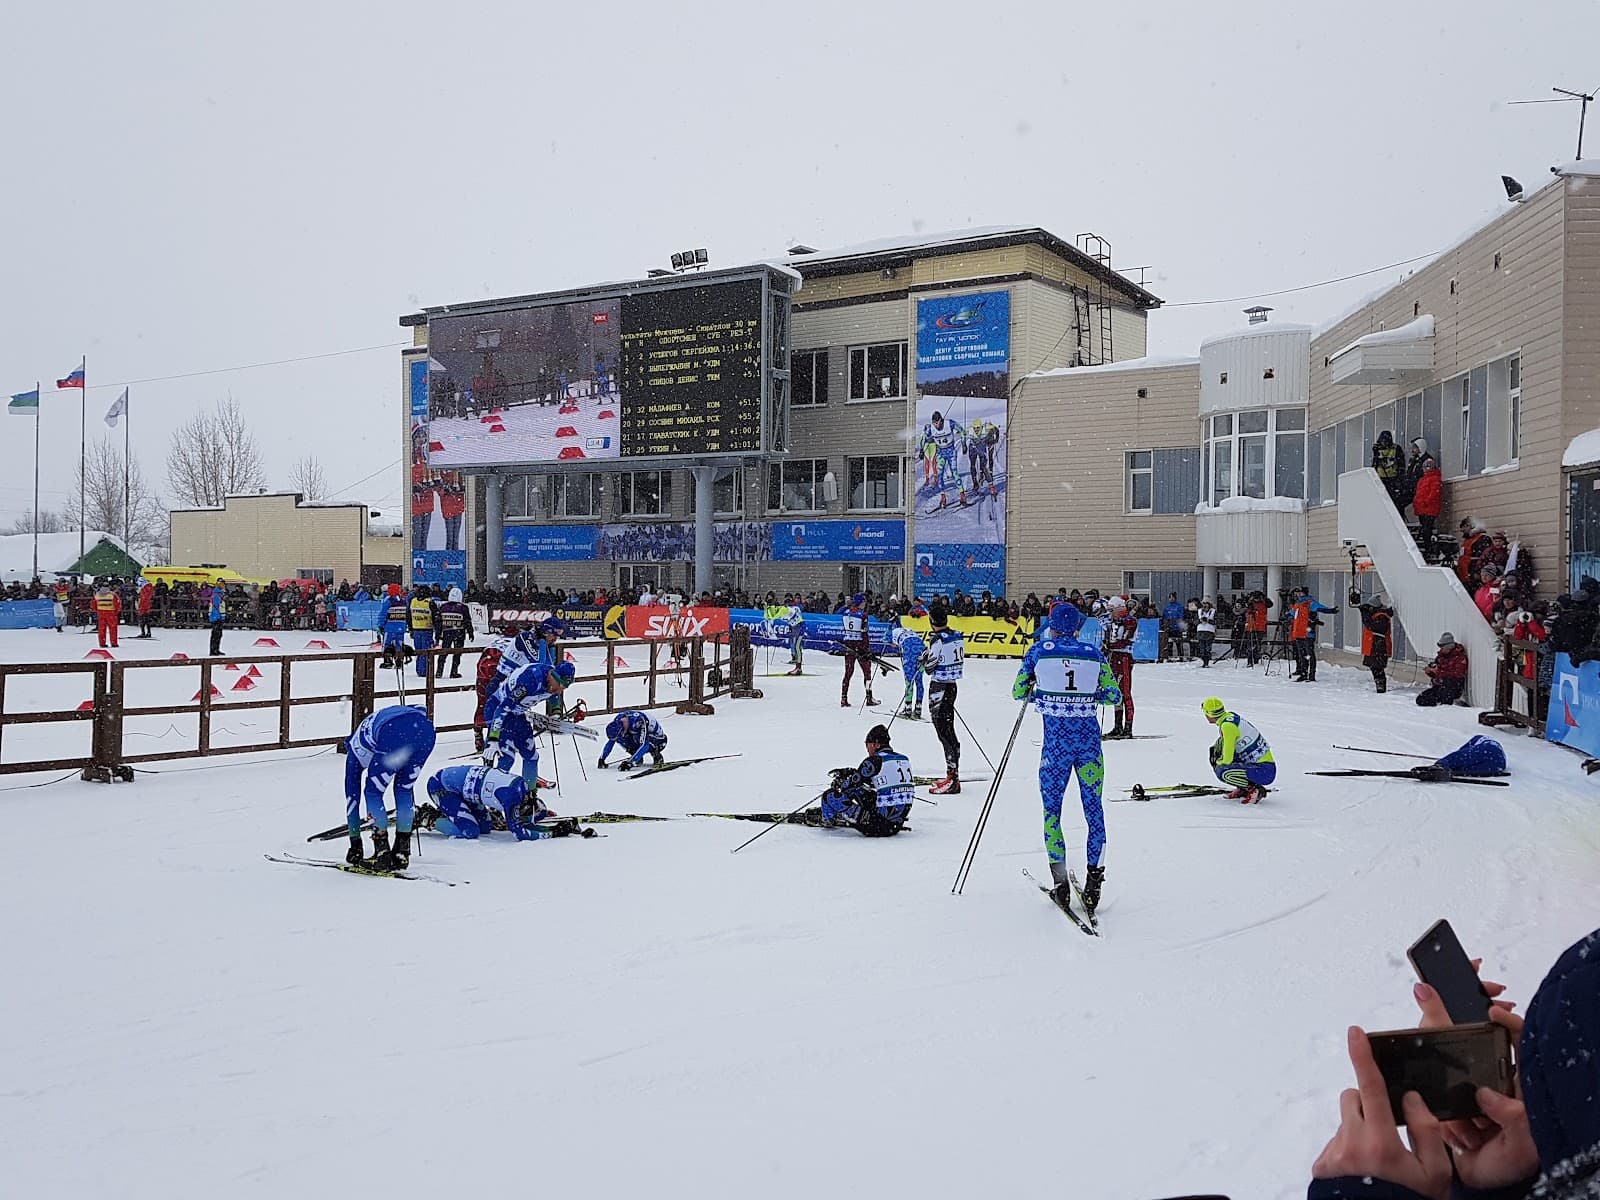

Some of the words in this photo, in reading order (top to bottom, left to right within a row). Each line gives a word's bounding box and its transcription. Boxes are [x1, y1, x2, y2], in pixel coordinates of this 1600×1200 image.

[735, 319, 744, 328] 30
[859, 530, 885, 538] mondi
[971, 560, 1000, 569] mondi
[491, 608, 552, 622] YOKO
[848, 620, 854, 630] 6
[1064, 669, 1078, 691] 1
[896, 767, 914, 784] 11
